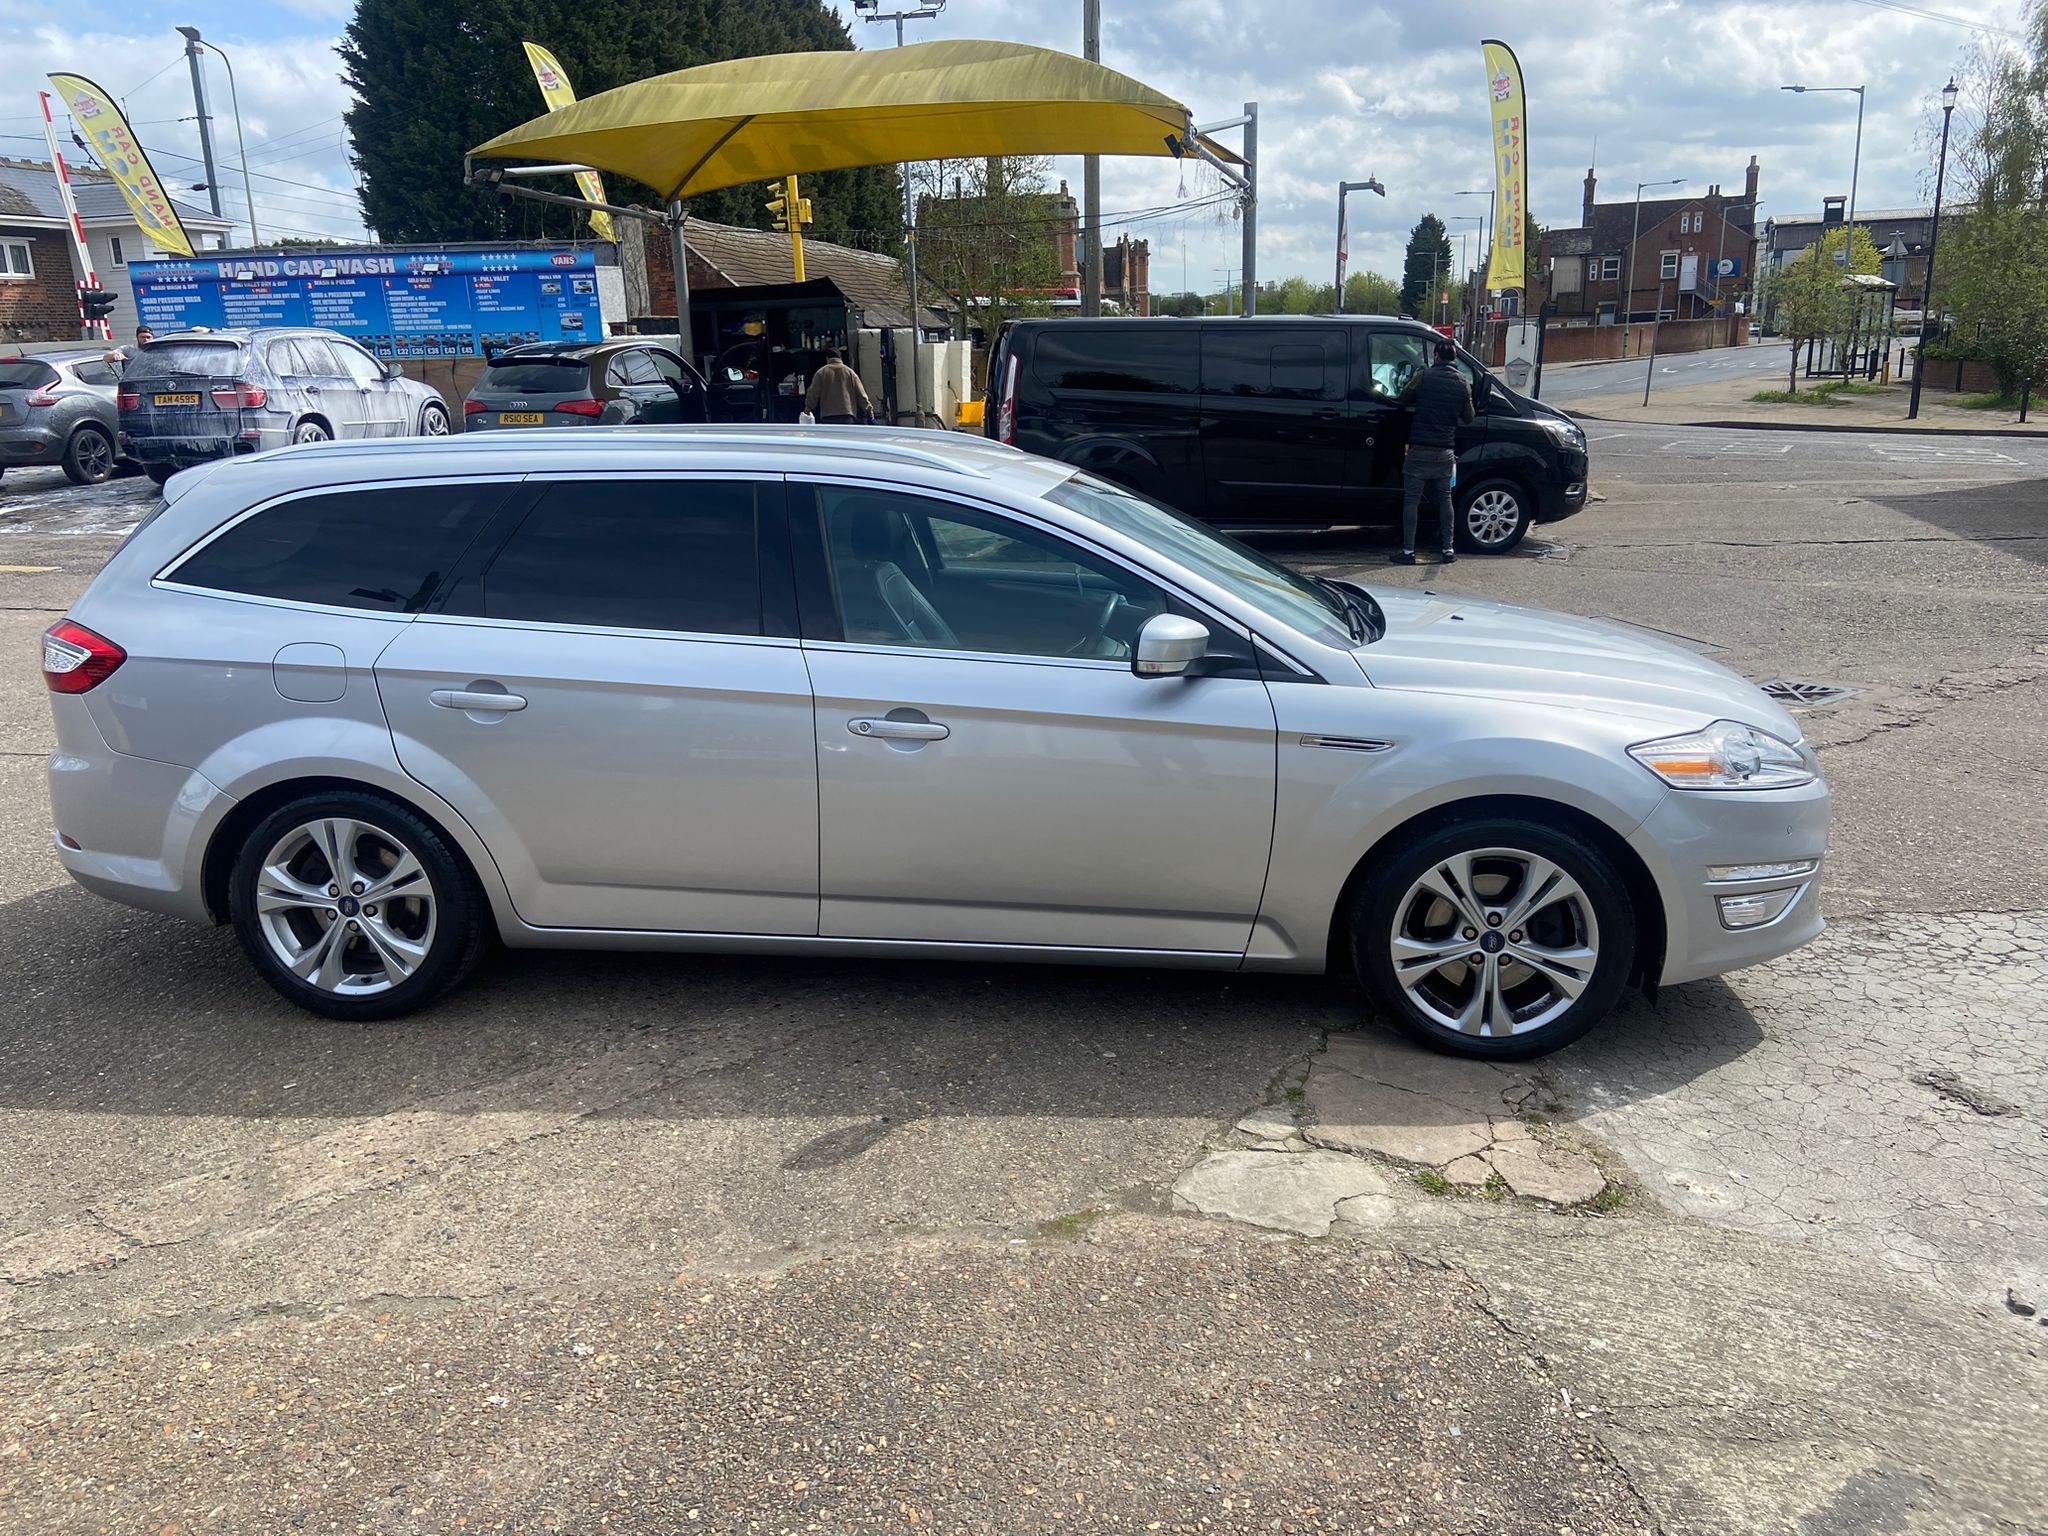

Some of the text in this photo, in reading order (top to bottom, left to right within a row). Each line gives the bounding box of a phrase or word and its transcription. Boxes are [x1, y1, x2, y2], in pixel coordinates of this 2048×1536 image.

[552, 257, 575, 265] VANS
[218, 261, 279, 278] HAND
[330, 258, 395, 274] WASH
[523, 414, 539, 422] SEA
